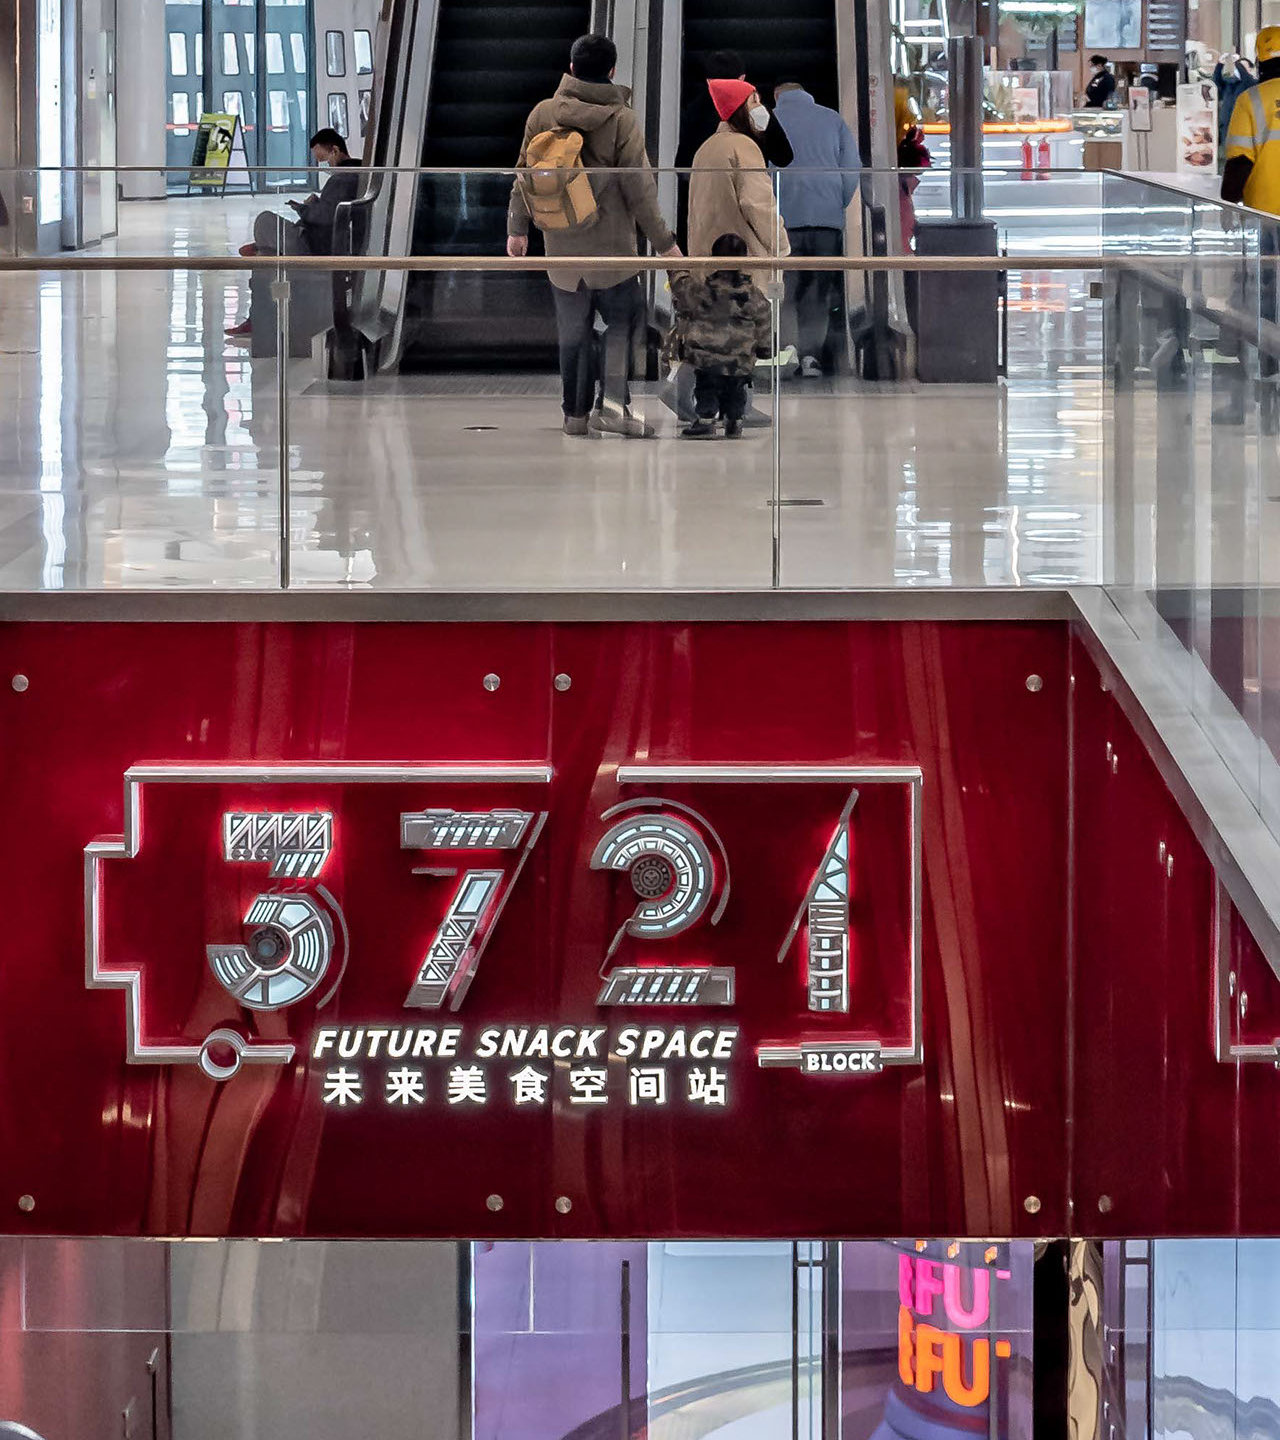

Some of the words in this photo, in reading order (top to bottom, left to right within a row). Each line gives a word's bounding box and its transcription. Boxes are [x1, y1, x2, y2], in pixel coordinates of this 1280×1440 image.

[206, 787, 859, 1014] 3721
[313, 1028, 462, 1060] FUTURE
[475, 1028, 601, 1059] SNACK
[615, 1028, 738, 1061] SPACE
[806, 1052, 877, 1071] BLOCK
[323, 1066, 729, 1106] 未来美食空间站
